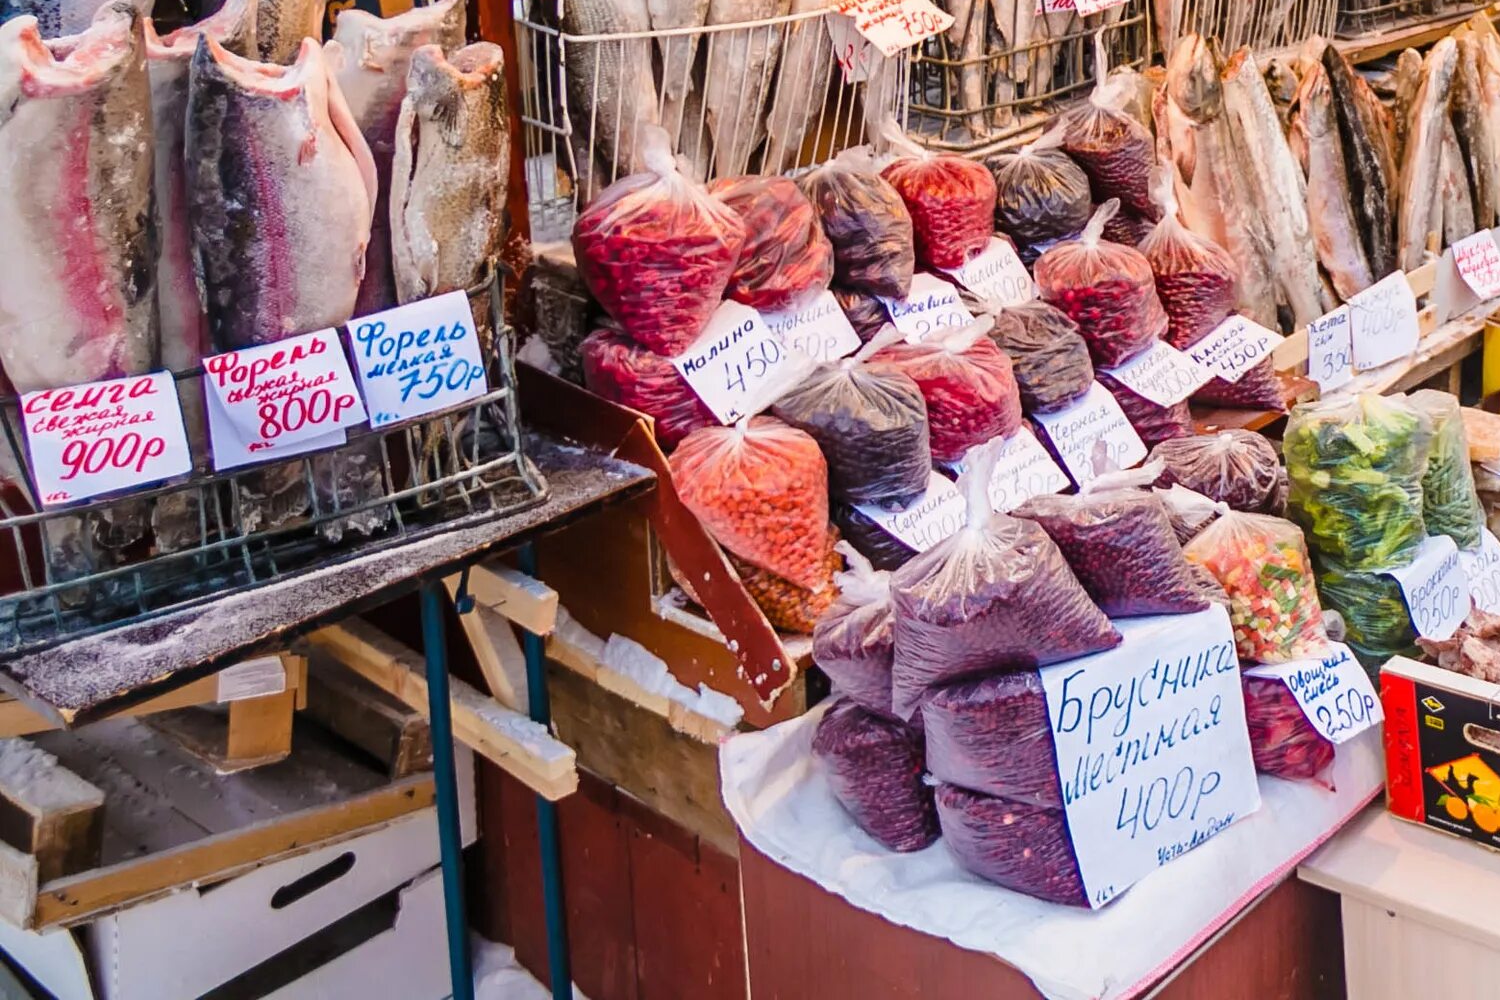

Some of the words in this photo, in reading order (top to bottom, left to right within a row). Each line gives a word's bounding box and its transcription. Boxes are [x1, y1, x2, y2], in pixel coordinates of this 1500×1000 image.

[208, 337, 327, 392] Форель
[357, 320, 468, 361] Форель
[1057, 640, 1237, 744] Брусника
